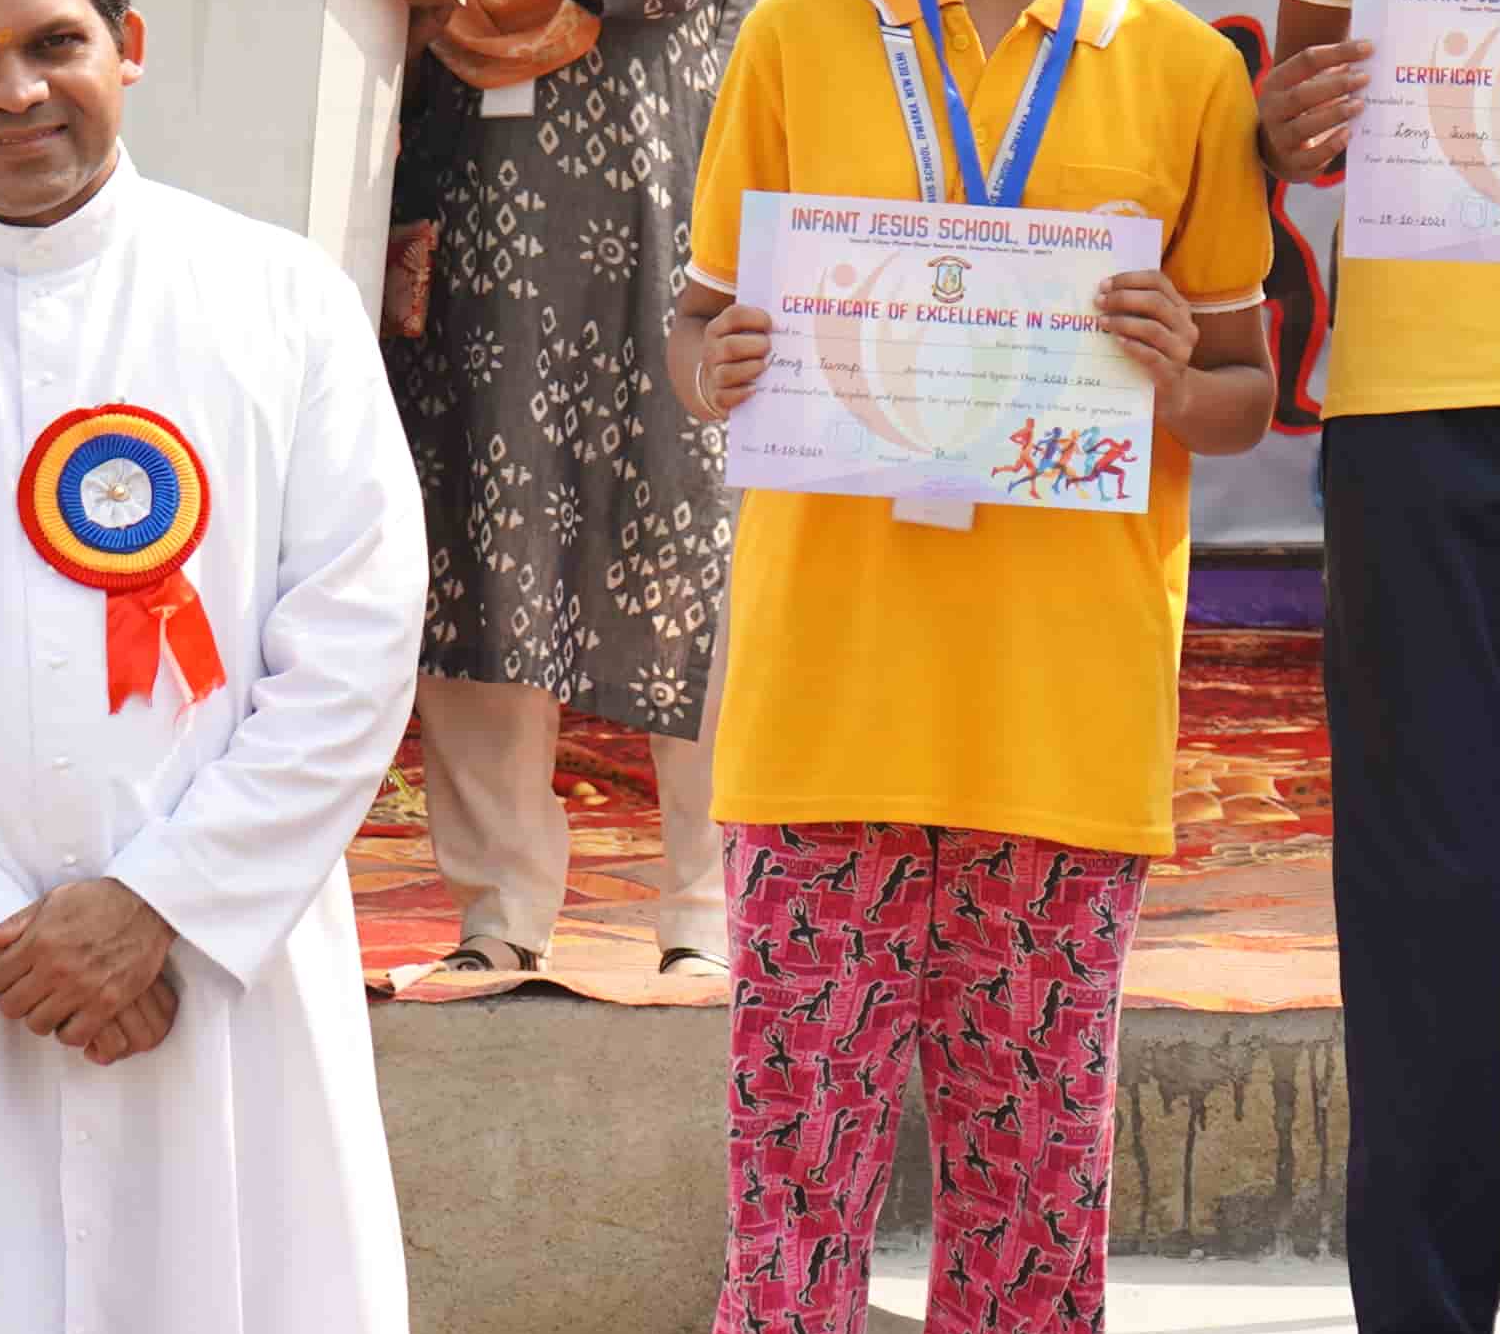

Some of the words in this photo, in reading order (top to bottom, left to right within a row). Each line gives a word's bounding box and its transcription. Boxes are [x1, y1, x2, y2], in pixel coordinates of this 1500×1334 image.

[1395, 65, 1493, 87] CERTIFICATE
[791, 207, 860, 234] INFANT
[868, 213, 929, 239] JESUS
[1028, 223, 1114, 252] DWARKA
[782, 295, 880, 319] CERTIFICATE
[888, 302, 908, 321] OF
[916, 304, 1018, 329] EXCELLENCE
[1027, 311, 1042, 330] IN
[1050, 313, 1109, 334] SPORT
